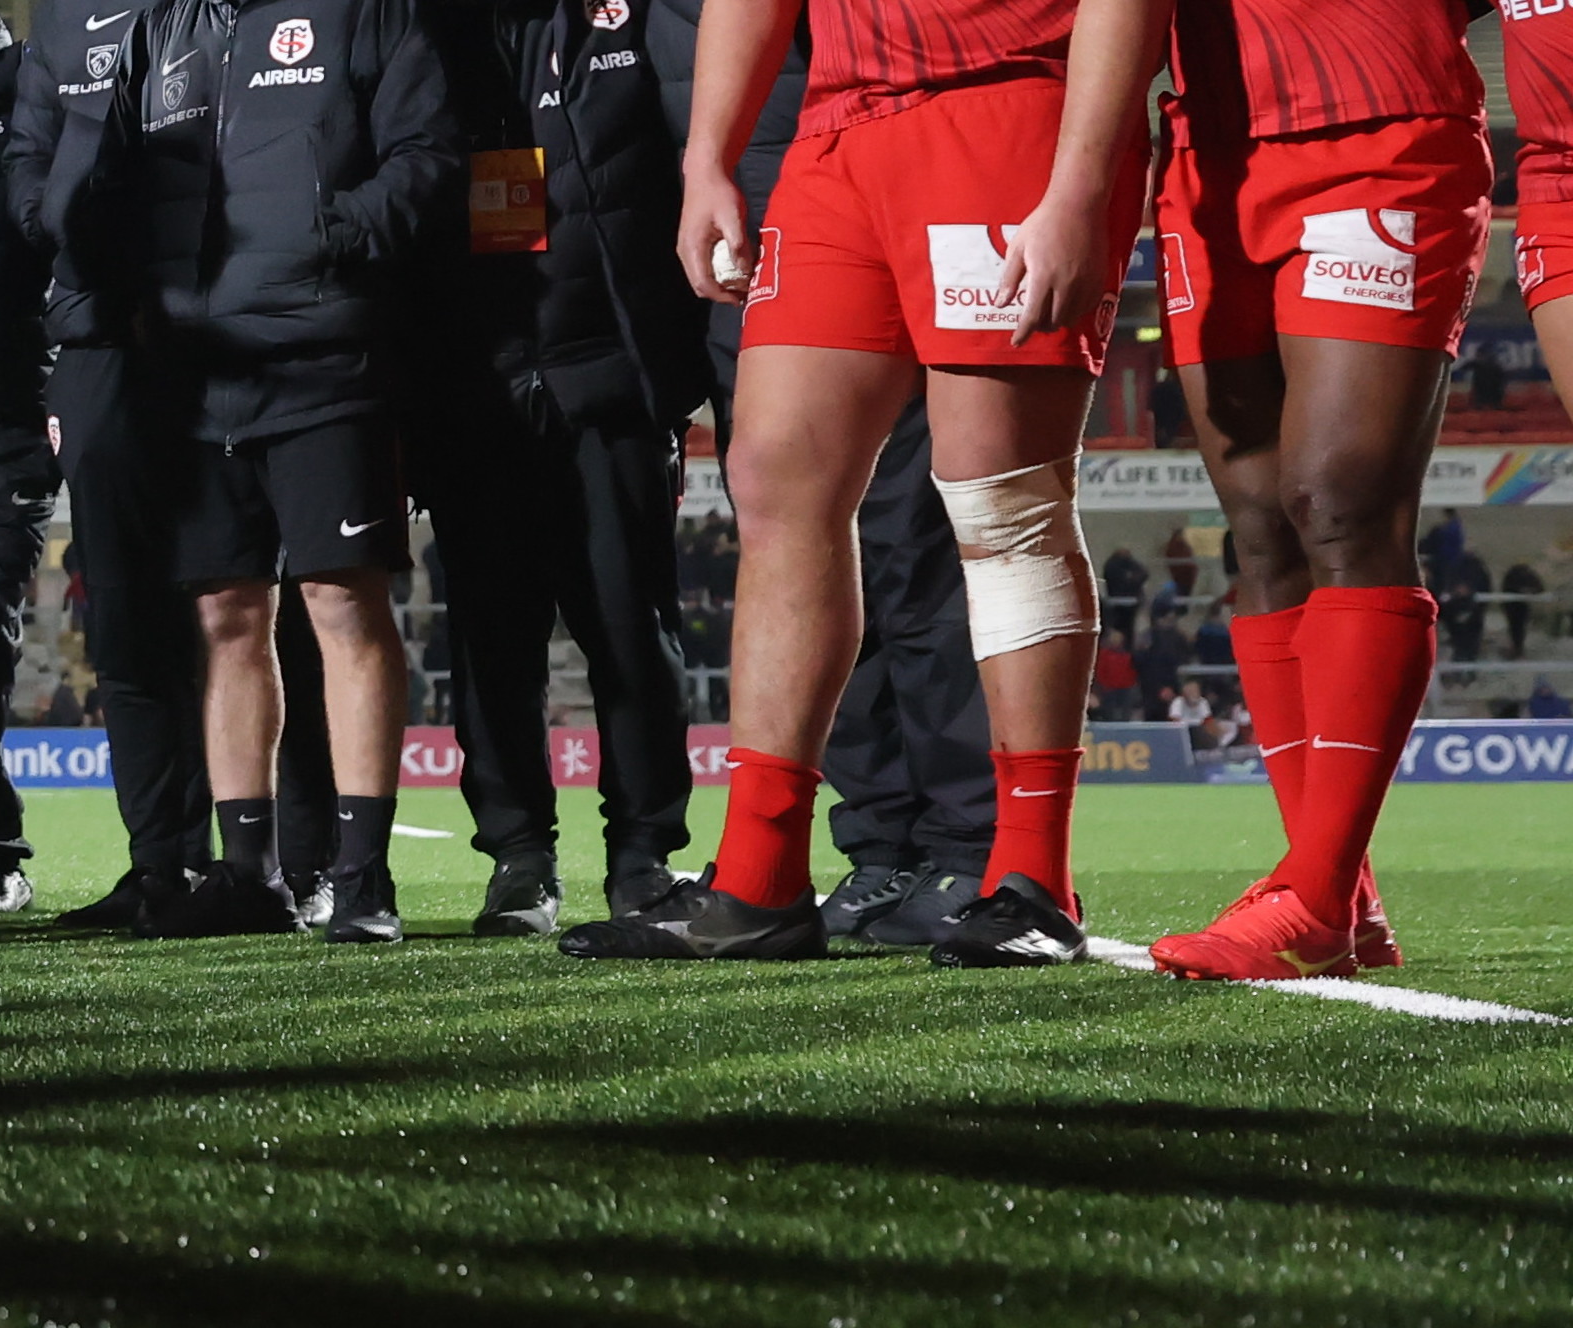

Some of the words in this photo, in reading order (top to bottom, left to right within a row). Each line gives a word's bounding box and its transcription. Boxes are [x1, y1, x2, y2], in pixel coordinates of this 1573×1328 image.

[589, 49, 637, 72] AIRB
[58, 78, 114, 96] PEUGE
[248, 66, 325, 88] AIRBUS
[142, 105, 209, 133] PEUGEOT
[1314, 259, 1408, 287] SOLVEO
[1343, 285, 1406, 303] ENERGIES
[975, 312, 1022, 323] ENERGI
[1167, 465, 1207, 484] TEE
[1434, 734, 1573, 776] GOW
